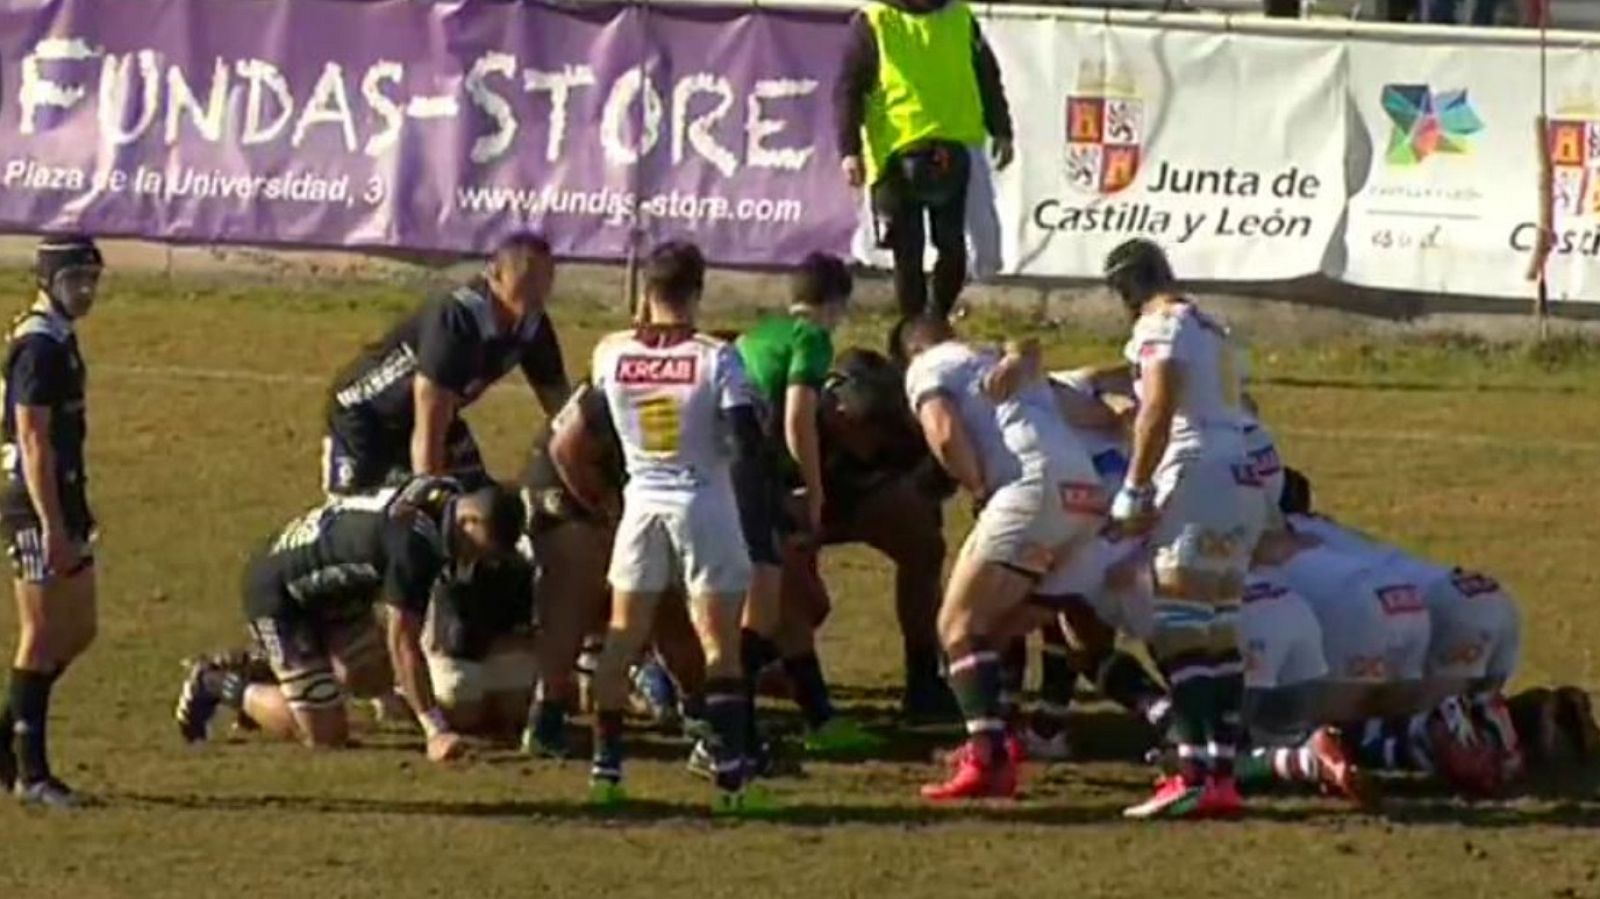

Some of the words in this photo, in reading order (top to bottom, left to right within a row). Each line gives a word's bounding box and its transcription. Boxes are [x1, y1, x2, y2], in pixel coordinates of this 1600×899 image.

[19, 37, 818, 177] FUNDAS-STORE
[4, 160, 84, 189] Plaza
[134, 165, 162, 193] la
[169, 168, 354, 208] Universidad,
[363, 174, 384, 204] 3
[1147, 161, 1260, 197] Junta
[1271, 167, 1320, 199] de
[1033, 199, 1171, 234] Castilla
[1176, 213, 1206, 243] y
[1214, 207, 1313, 238] León
[1509, 222, 1600, 256] Csti
